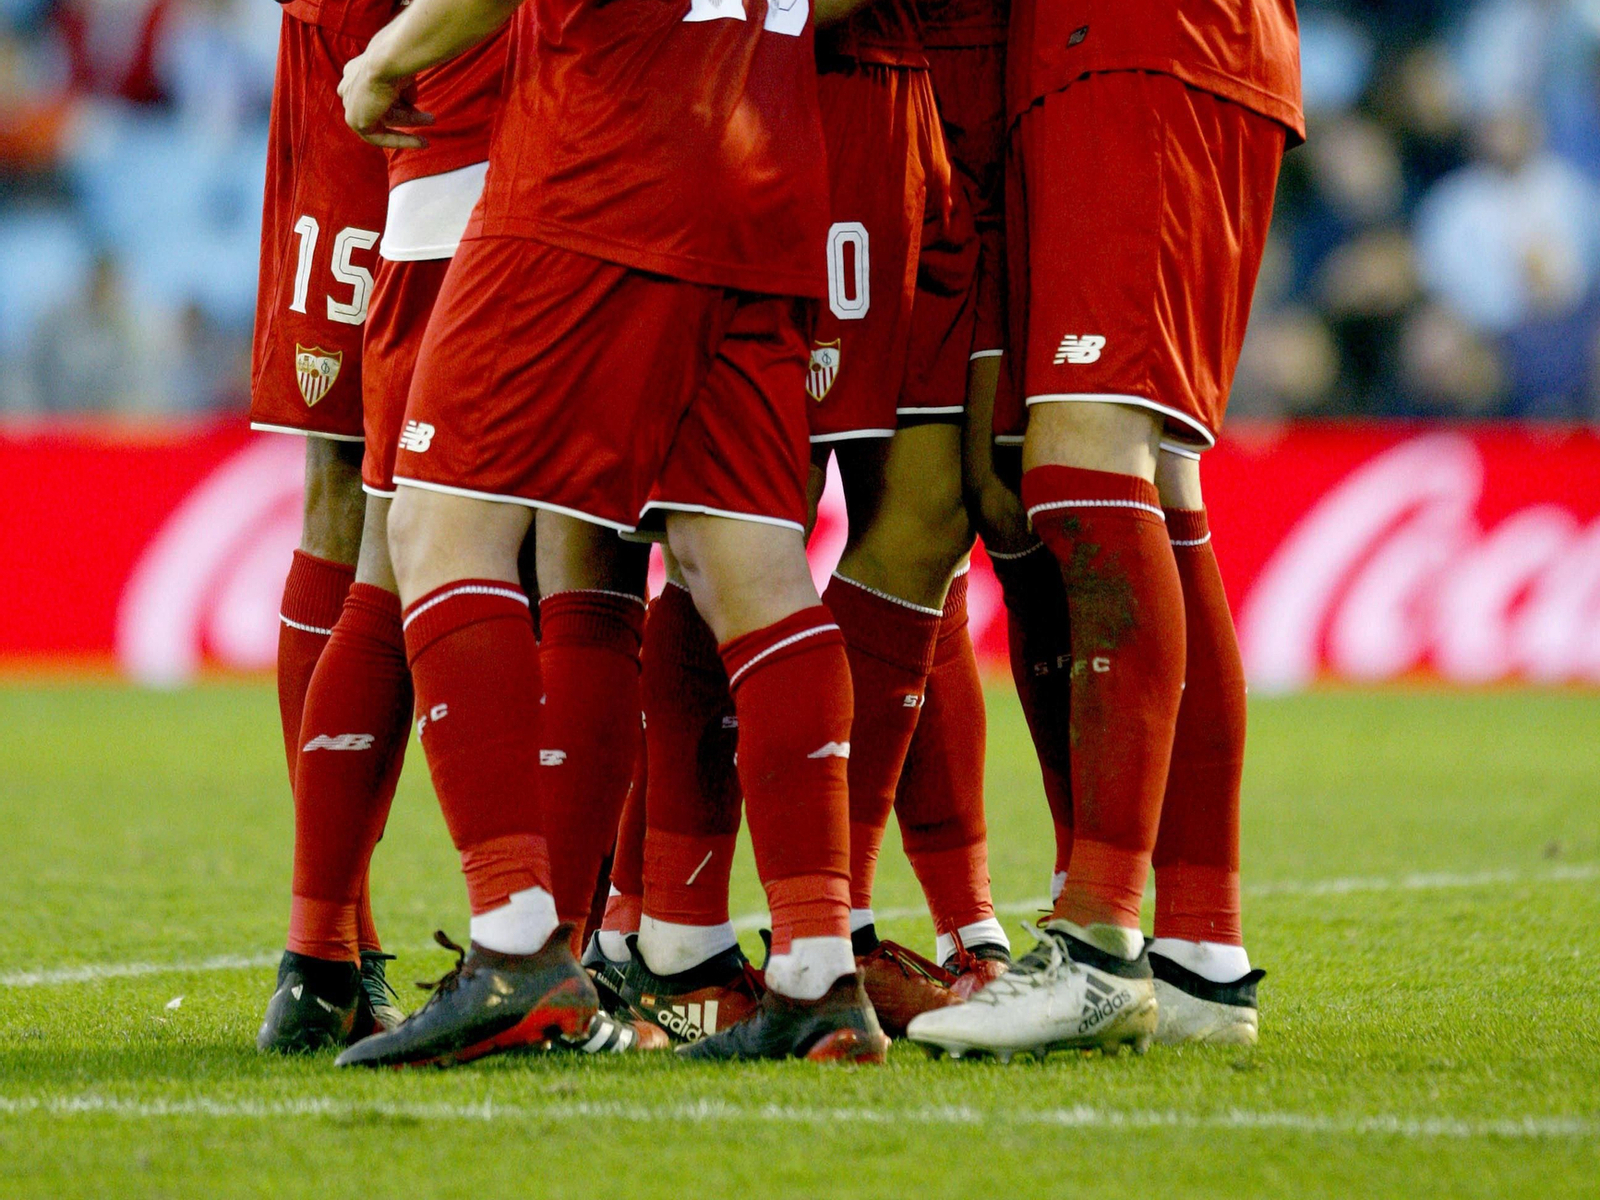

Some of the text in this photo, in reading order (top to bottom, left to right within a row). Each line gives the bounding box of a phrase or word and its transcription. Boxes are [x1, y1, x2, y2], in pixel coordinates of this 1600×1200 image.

[289, 215, 381, 326] 15
[657, 1009, 703, 1043] adid
[1078, 989, 1131, 1034] adidas
